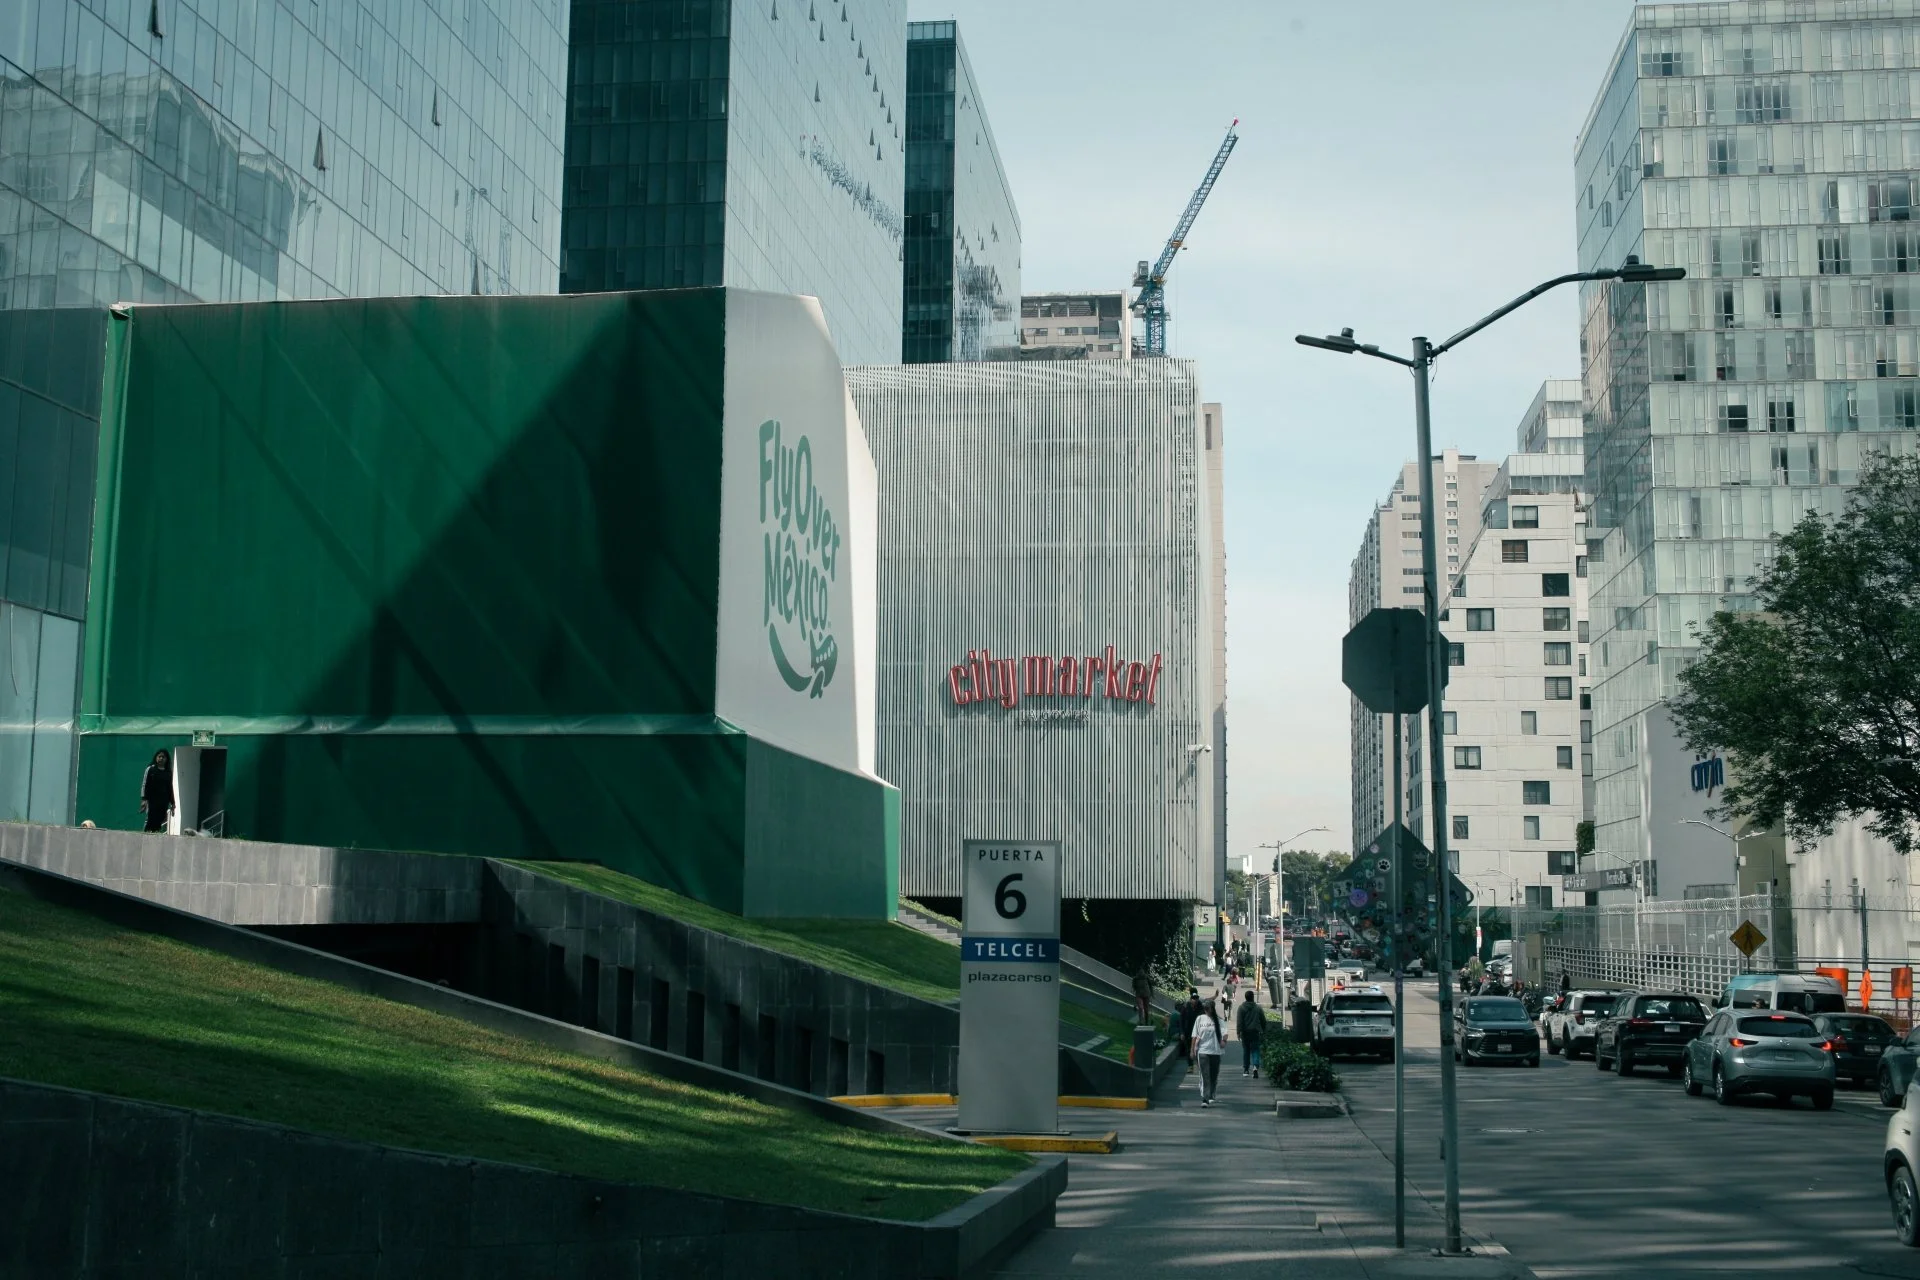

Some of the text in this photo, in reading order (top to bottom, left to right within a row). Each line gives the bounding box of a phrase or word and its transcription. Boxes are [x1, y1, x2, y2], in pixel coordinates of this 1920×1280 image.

[759, 420, 840, 581] FlyOver
[764, 531, 828, 641] México
[978, 849, 1044, 861] PUERTA
[994, 873, 1027, 919] 6
[1203, 913, 1209, 923] 5
[975, 942, 1046, 957] TELCEL
[968, 971, 1052, 983] plazacarso
